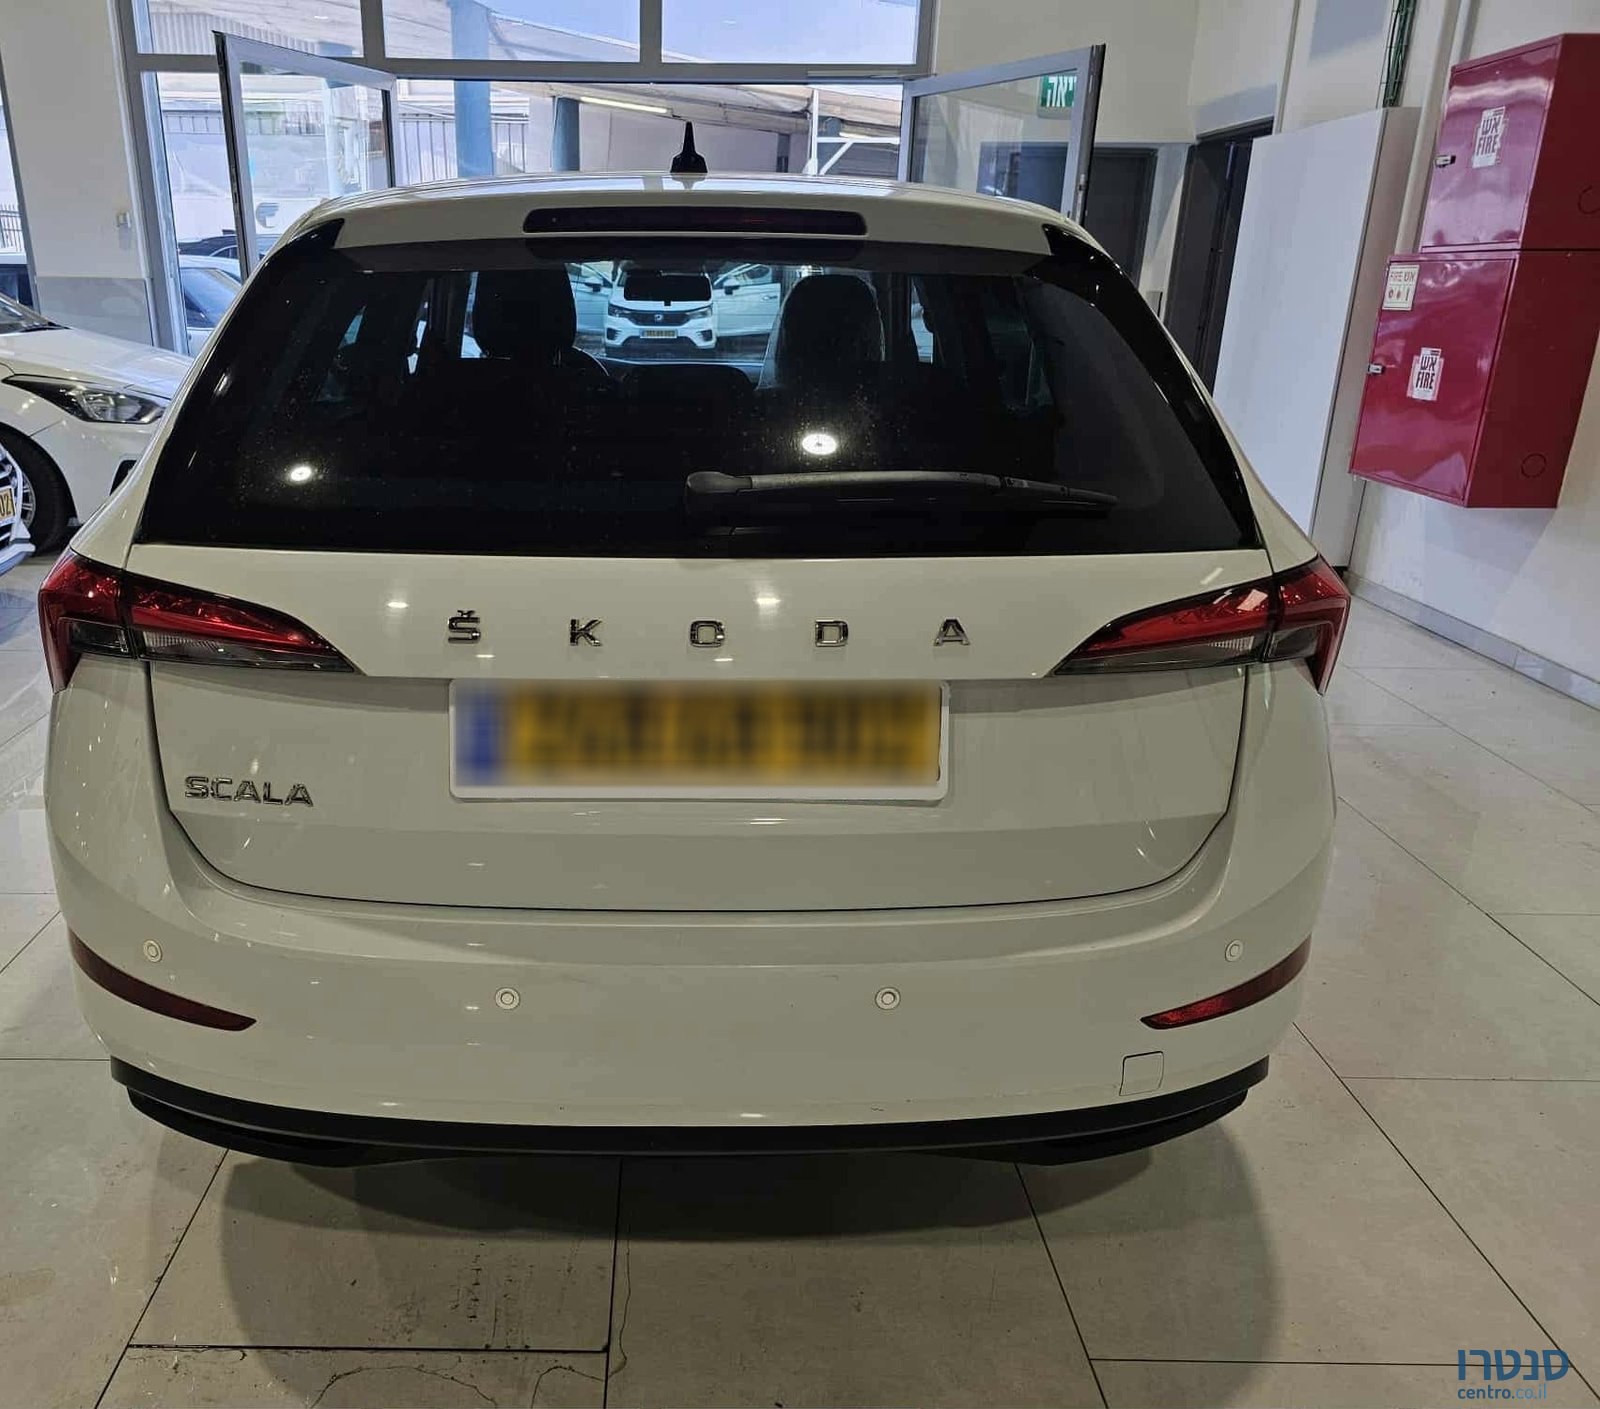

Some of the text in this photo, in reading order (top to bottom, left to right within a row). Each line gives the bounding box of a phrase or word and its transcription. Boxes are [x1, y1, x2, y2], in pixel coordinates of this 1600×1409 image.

[1046, 75, 1077, 107] יאה
[1481, 116, 1501, 136] אש
[1476, 133, 1499, 156] FIRE
[1420, 356, 1437, 371] אש
[1415, 370, 1435, 389] FIRE
[447, 609, 971, 648] ŠKODA
[184, 776, 314, 807] SCALA
